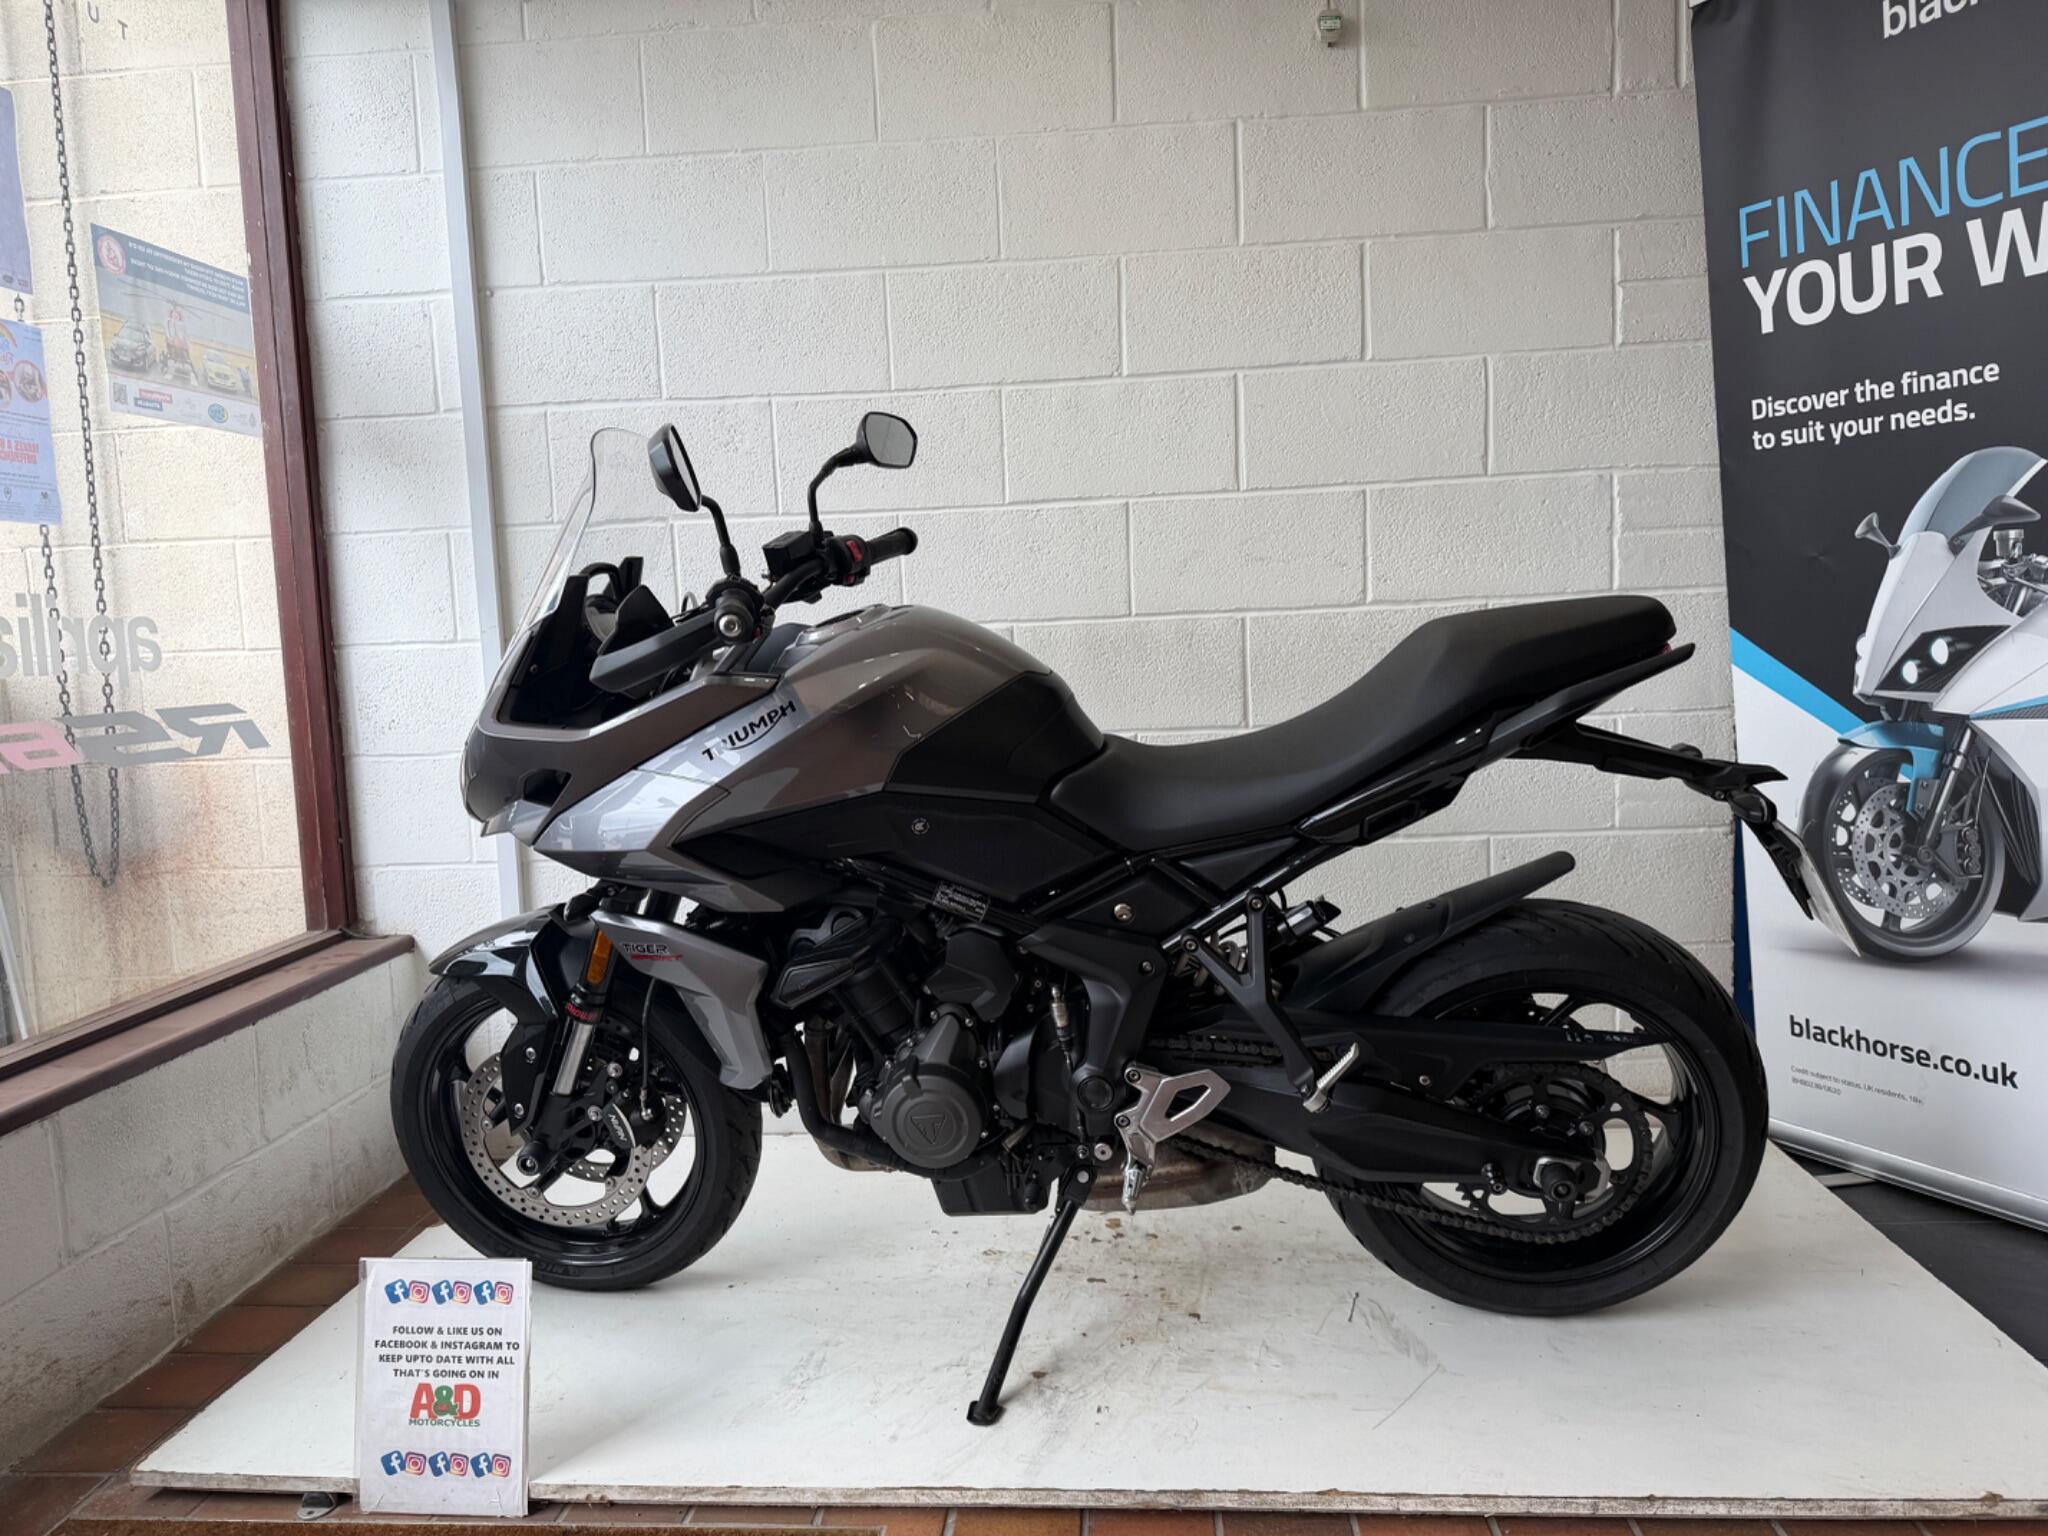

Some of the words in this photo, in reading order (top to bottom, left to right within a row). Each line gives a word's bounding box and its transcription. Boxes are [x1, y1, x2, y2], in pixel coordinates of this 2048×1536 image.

[1882, 0, 1979, 39] bla
[1738, 115, 2048, 269] FINANCE
[1742, 231, 1944, 334] YOUR
[1751, 388, 1849, 420] Discover
[1854, 379, 1895, 404] the
[1900, 362, 2000, 396] finance
[1752, 430, 1776, 450] to
[1781, 420, 1825, 447] suit
[1830, 414, 1884, 445] your
[1890, 399, 1976, 430] needs.
[701, 700, 797, 761] TIUMPH
[621, 942, 669, 954] TIGER
[1789, 1014, 2019, 1089] blackhorse.co.uk
[374, 1340, 428, 1349] FACEBOOK
[430, 1341, 438, 1349] &
[441, 1341, 503, 1350] INSTAGRAM
[506, 1342, 520, 1351] TO
[392, 1326, 434, 1335] FOLLOW
[437, 1327, 444, 1335] &
[447, 1327, 468, 1336] LIKE
[471, 1327, 484, 1336] US
[486, 1327, 503, 1336] ON
[379, 1354, 403, 1363] KEEP
[405, 1355, 433, 1363] UPTO
[436, 1355, 463, 1364] DATE
[465, 1356, 493, 1365] WITH
[496, 1356, 515, 1365] ALL
[393, 1369, 430, 1378] THAT'S
[432, 1370, 466, 1379] GOING
[469, 1370, 485, 1379] ON
[488, 1371, 500, 1379] IN
[409, 1382, 481, 1419] A&D
[408, 1418, 481, 1428] MOTORCYCLES
